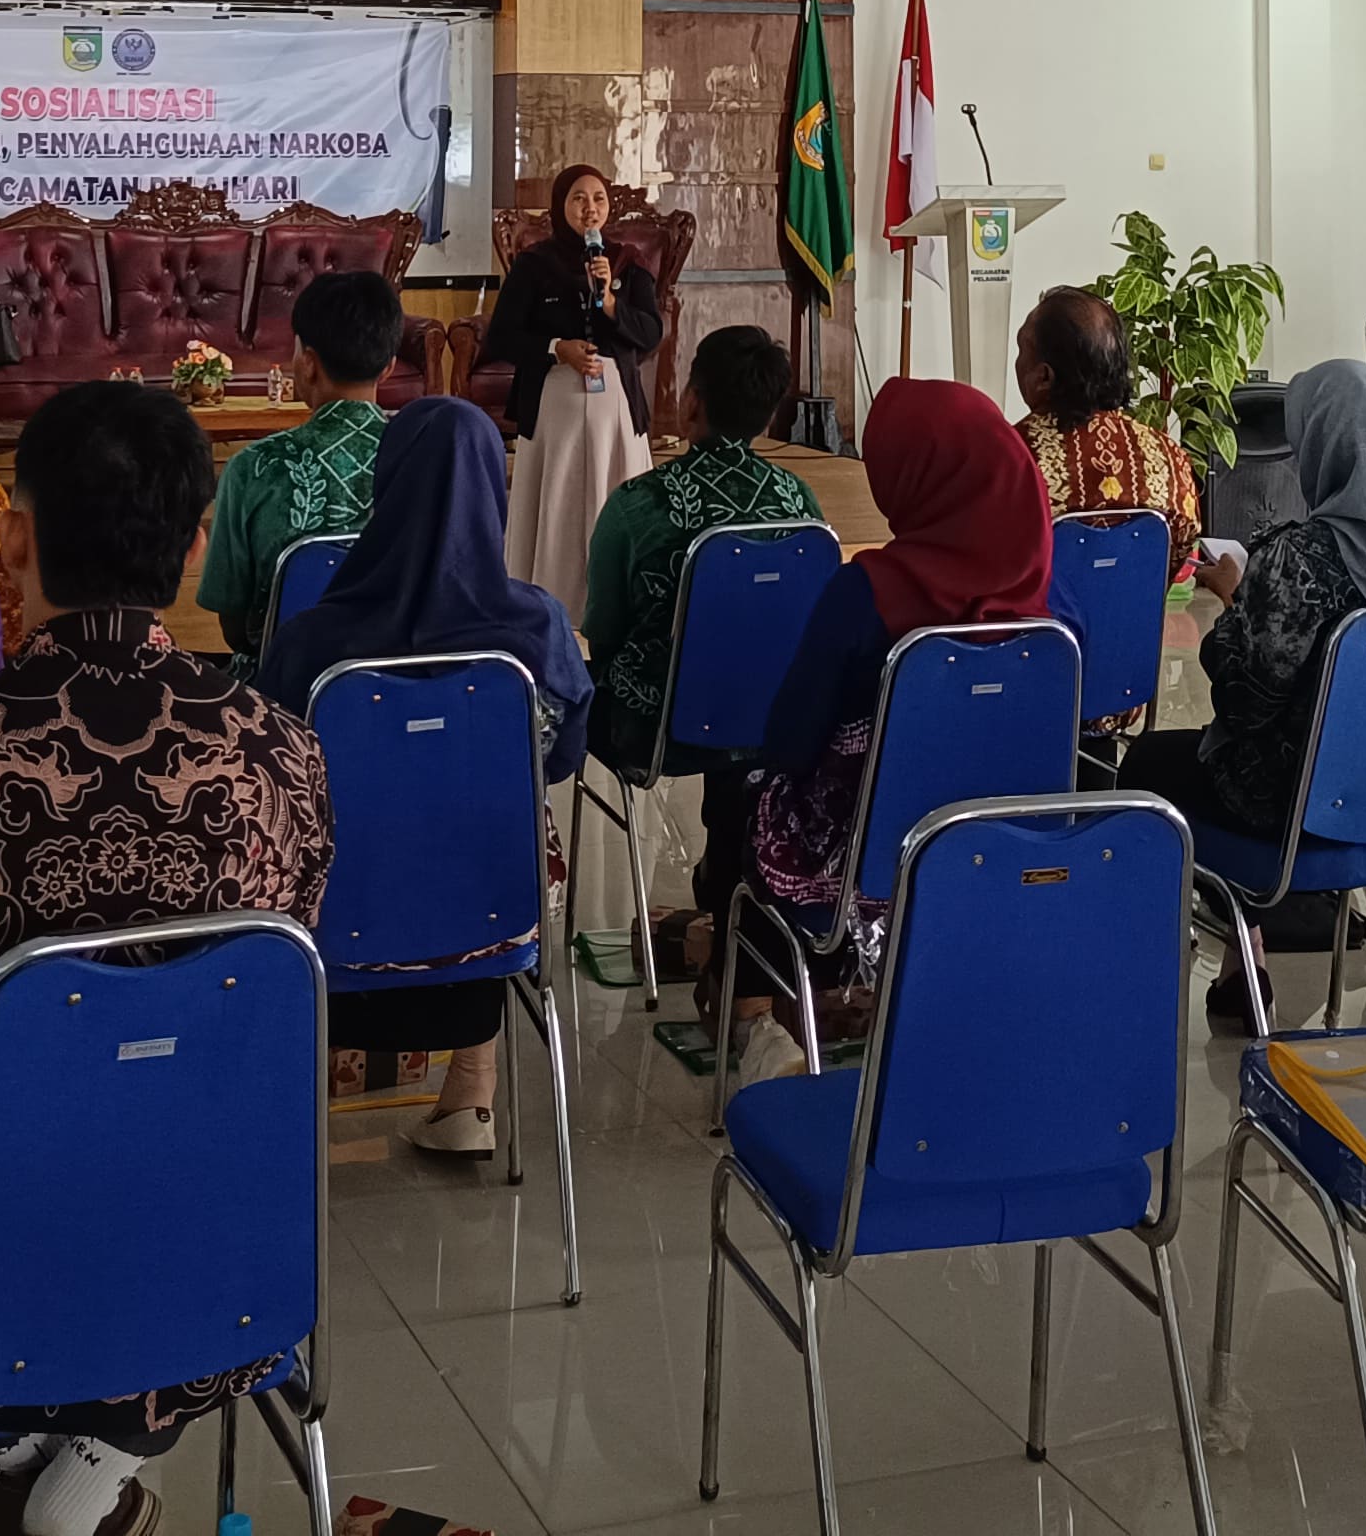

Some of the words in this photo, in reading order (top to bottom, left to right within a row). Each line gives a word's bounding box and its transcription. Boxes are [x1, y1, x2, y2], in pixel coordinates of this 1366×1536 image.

[0, 86, 217, 122] SOSIALISASI
[16, 131, 264, 159] PENYALAHGUNAAN
[268, 131, 392, 159] NARKOBA
